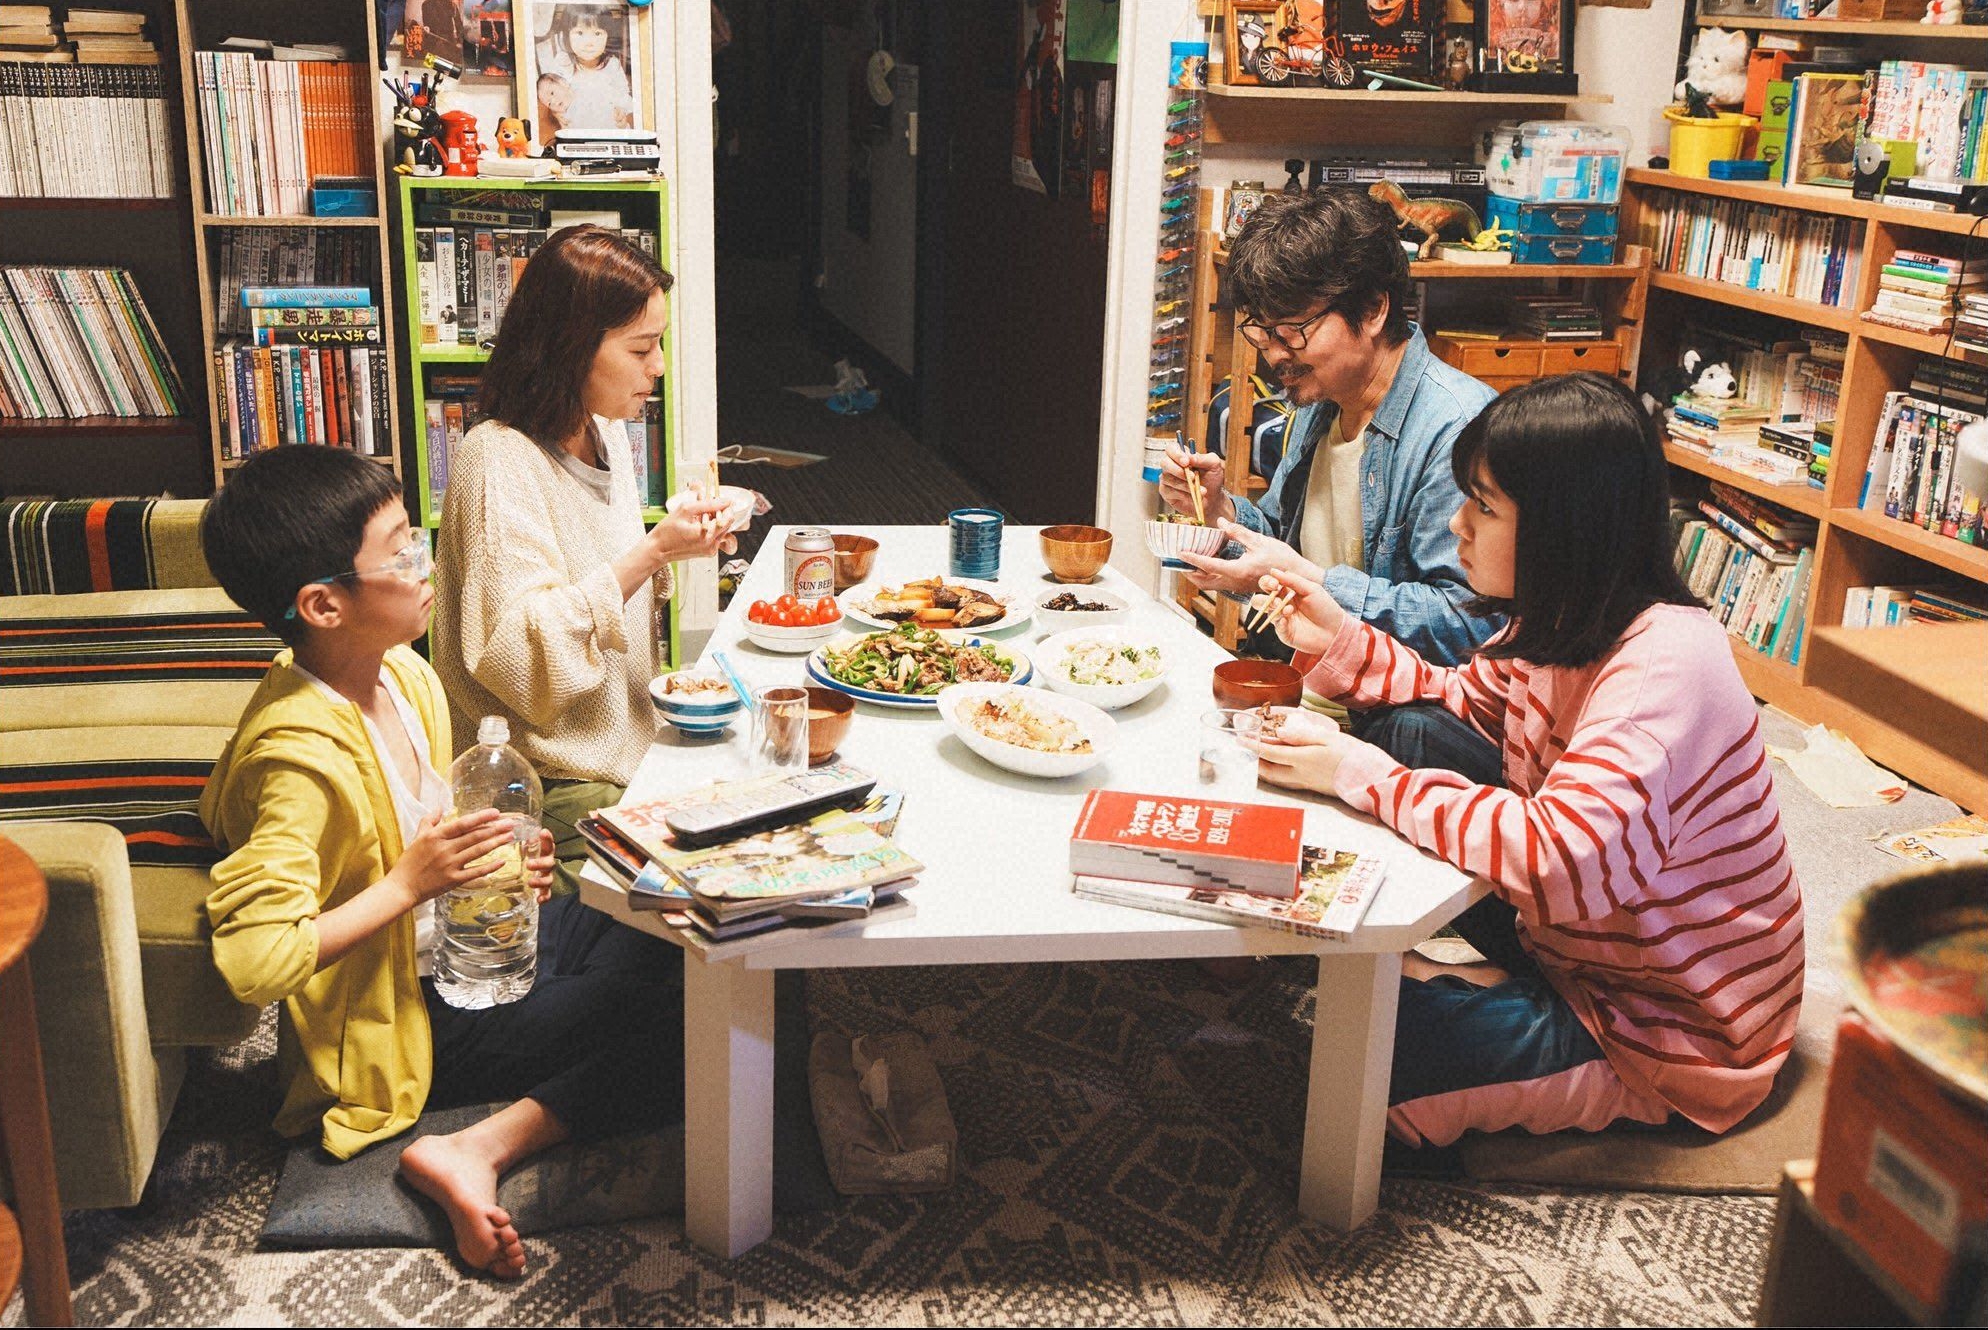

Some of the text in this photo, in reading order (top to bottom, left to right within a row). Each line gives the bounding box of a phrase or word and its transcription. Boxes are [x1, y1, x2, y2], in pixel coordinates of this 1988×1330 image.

[1352, 43, 1418, 53] ホロウ・フェイス
[282, 309, 346, 325] 暴走男
[298, 330, 364, 343] ホワイトマン
[799, 581, 816, 590] SUN
